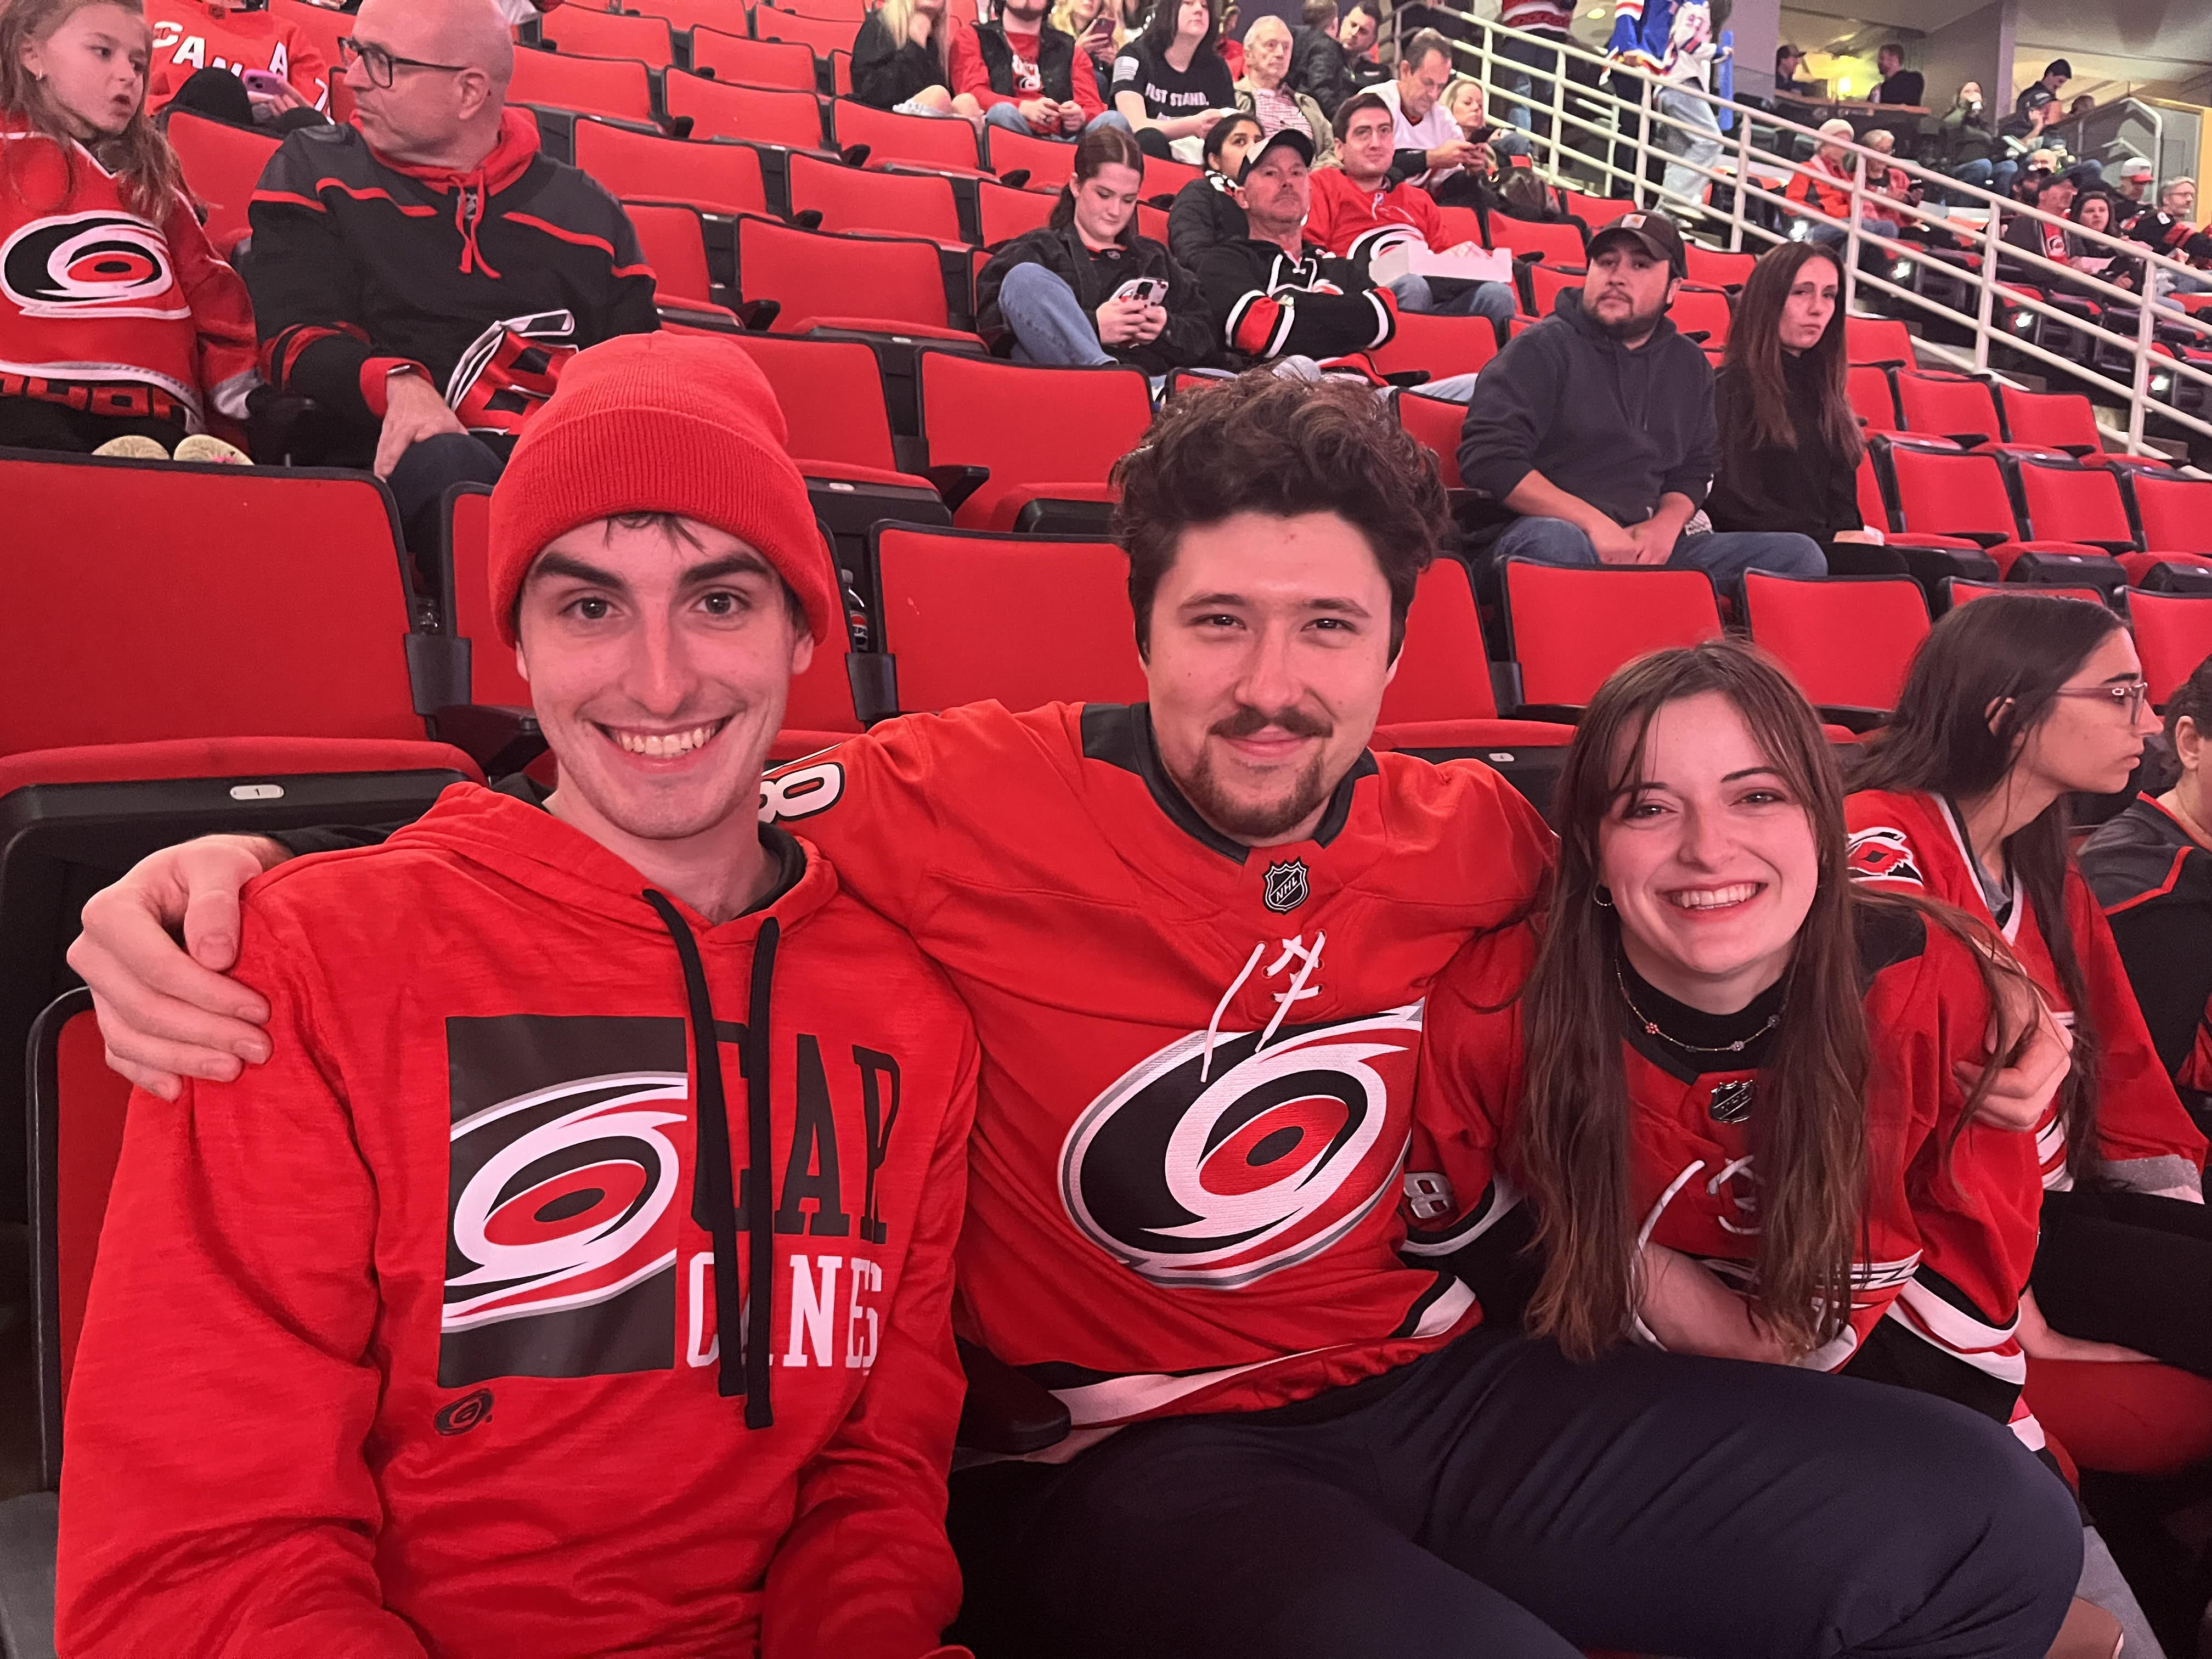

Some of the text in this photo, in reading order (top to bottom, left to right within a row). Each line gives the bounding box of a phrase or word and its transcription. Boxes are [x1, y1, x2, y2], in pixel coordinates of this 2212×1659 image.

[255, 788, 260, 797] 1
[1276, 876, 1297, 902] NHL
[687, 1251, 882, 1373] CNES
